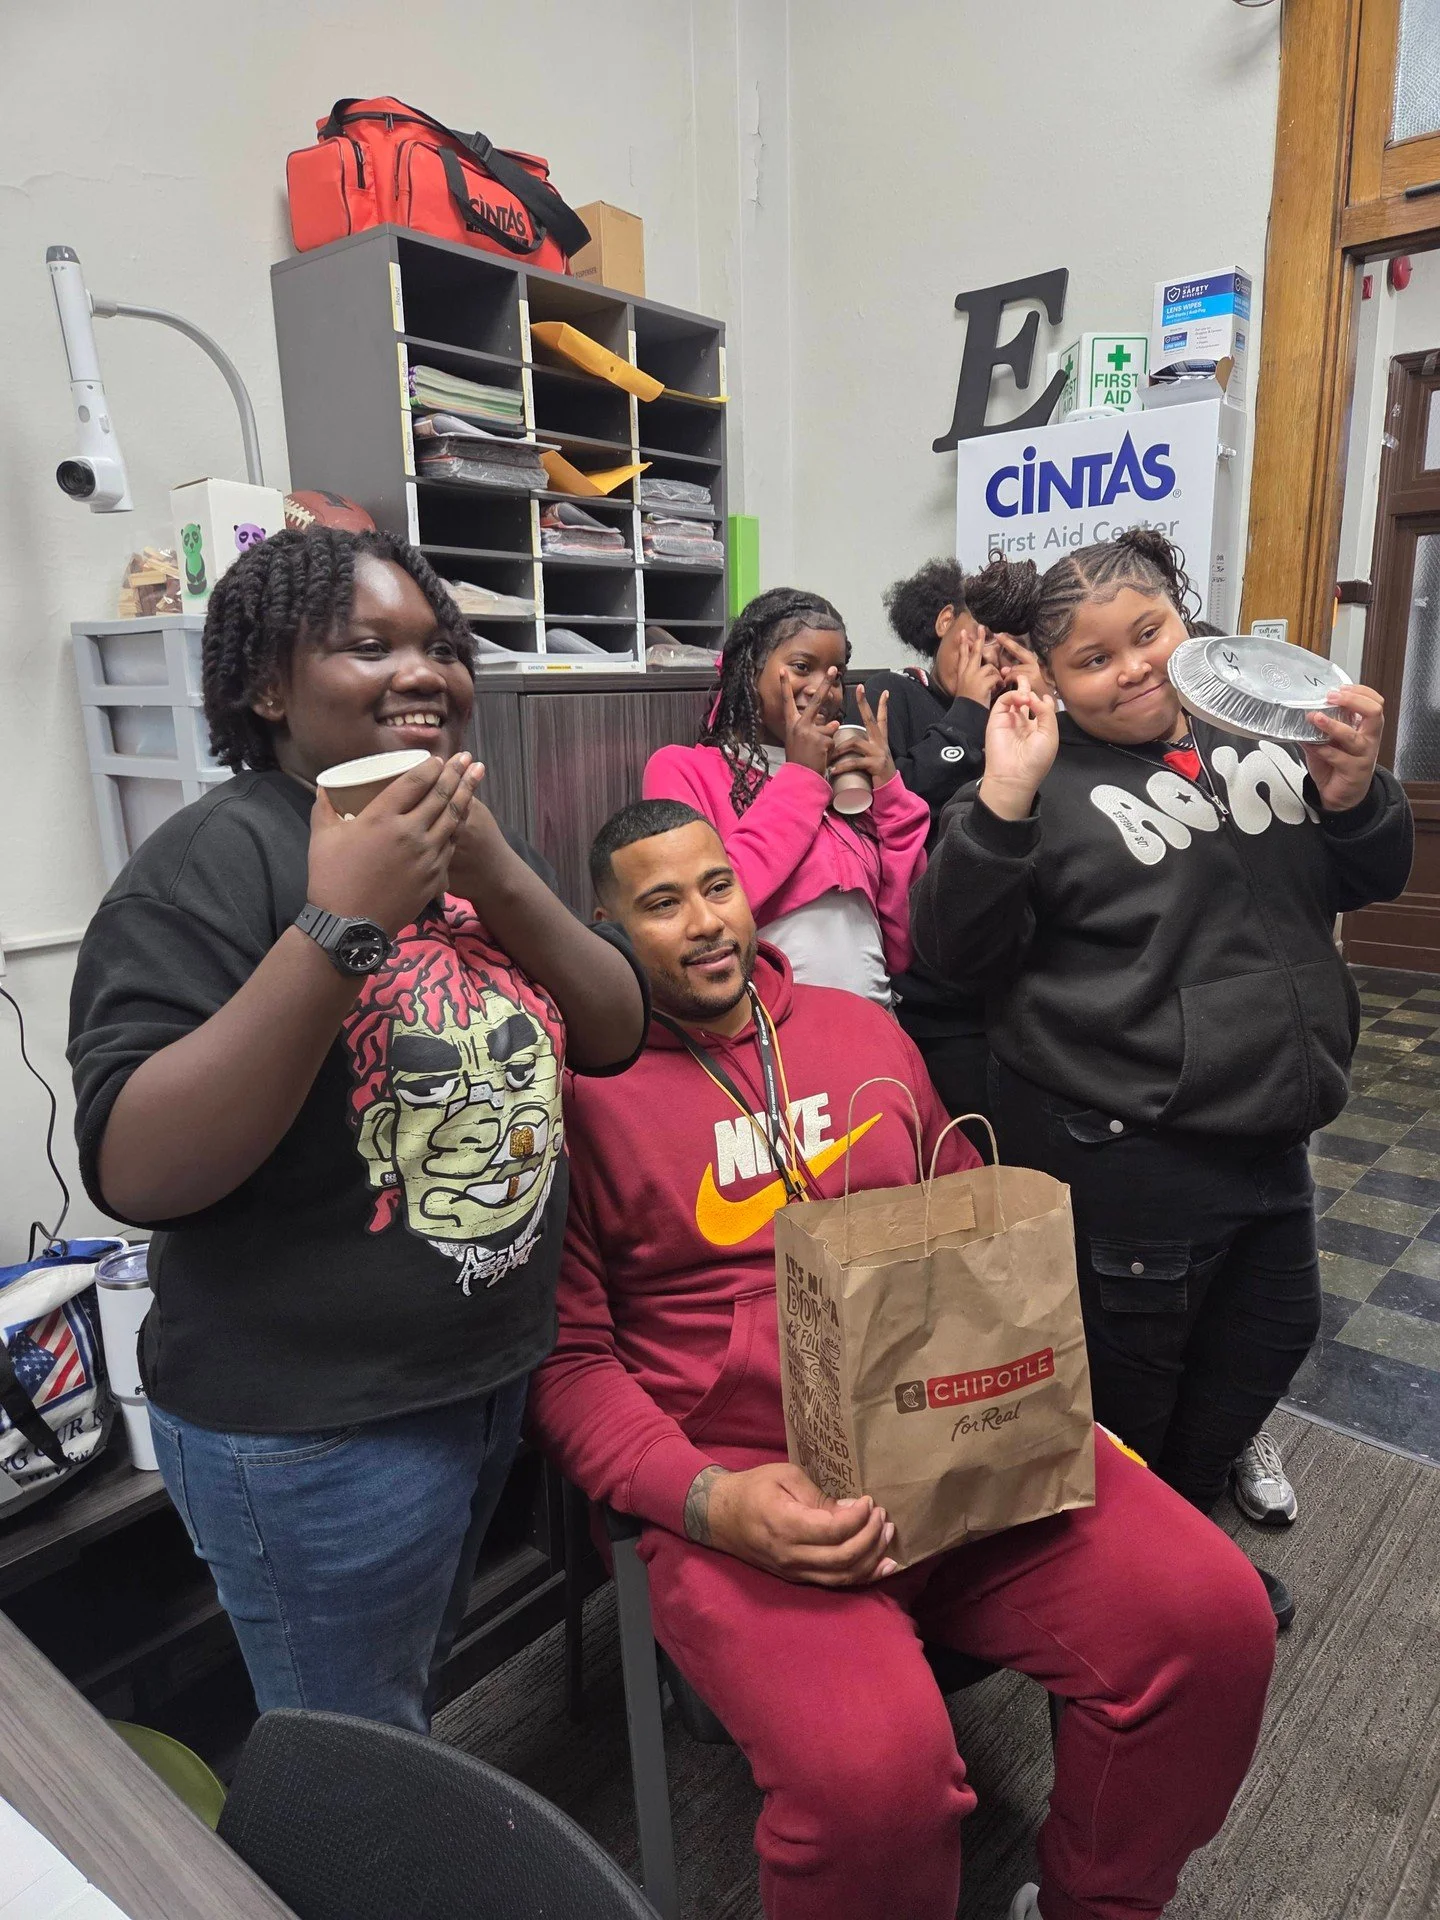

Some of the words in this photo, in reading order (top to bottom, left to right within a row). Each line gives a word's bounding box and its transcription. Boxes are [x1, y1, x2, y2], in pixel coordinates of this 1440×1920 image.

[1182, 284, 1209, 295] SAFETY
[1166, 305, 1182, 314] LENS
[1183, 301, 1202, 311] WIPES
[932, 267, 1069, 453] E
[1095, 373, 1138, 388] FIRST
[1103, 390, 1132, 404] AID
[988, 532, 1036, 553] First
[1043, 522, 1084, 548] Aid
[1115, 810, 1139, 841] ANGELES
[1134, 835, 1149, 849] LOS
[800, 1329, 820, 1354] FOIL
[933, 1355, 1049, 1401] CHIPOTLE
[951, 1414, 980, 1442] for
[981, 1400, 1022, 1433] Real
